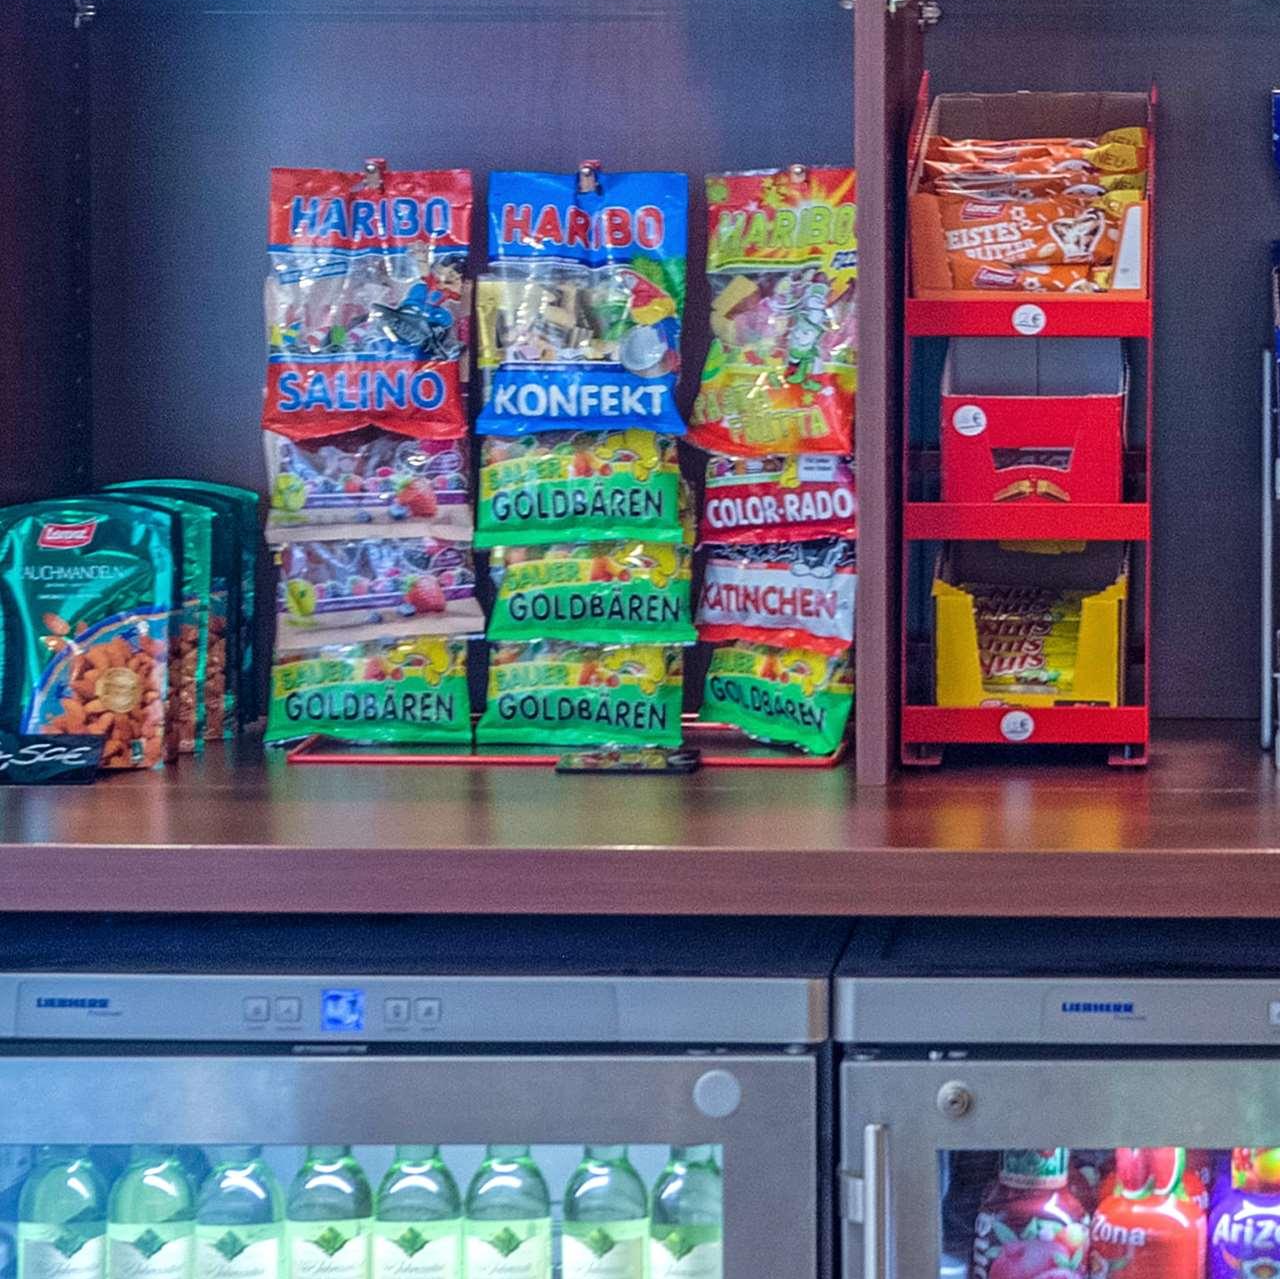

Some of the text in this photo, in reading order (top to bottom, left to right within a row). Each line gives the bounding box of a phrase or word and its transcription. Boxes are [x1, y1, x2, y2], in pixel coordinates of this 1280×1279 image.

[290, 196, 451, 240] HARIBO
[501, 204, 664, 250] HARIBO
[946, 222, 1022, 250] EISTES
[277, 371, 447, 412] SALINO
[493, 383, 668, 417] KONFEKT
[491, 483, 663, 521] GOLDBÄREN
[508, 589, 681, 622] GOLDBÄREN
[284, 689, 454, 722] GOLDBÄREN
[498, 692, 667, 731] GOLDBÄREN
[710, 677, 827, 730] GOLDBÄREN
[36, 997, 109, 1009] LIEBHERR
[1062, 1002, 1135, 1014] LIEBHERR
